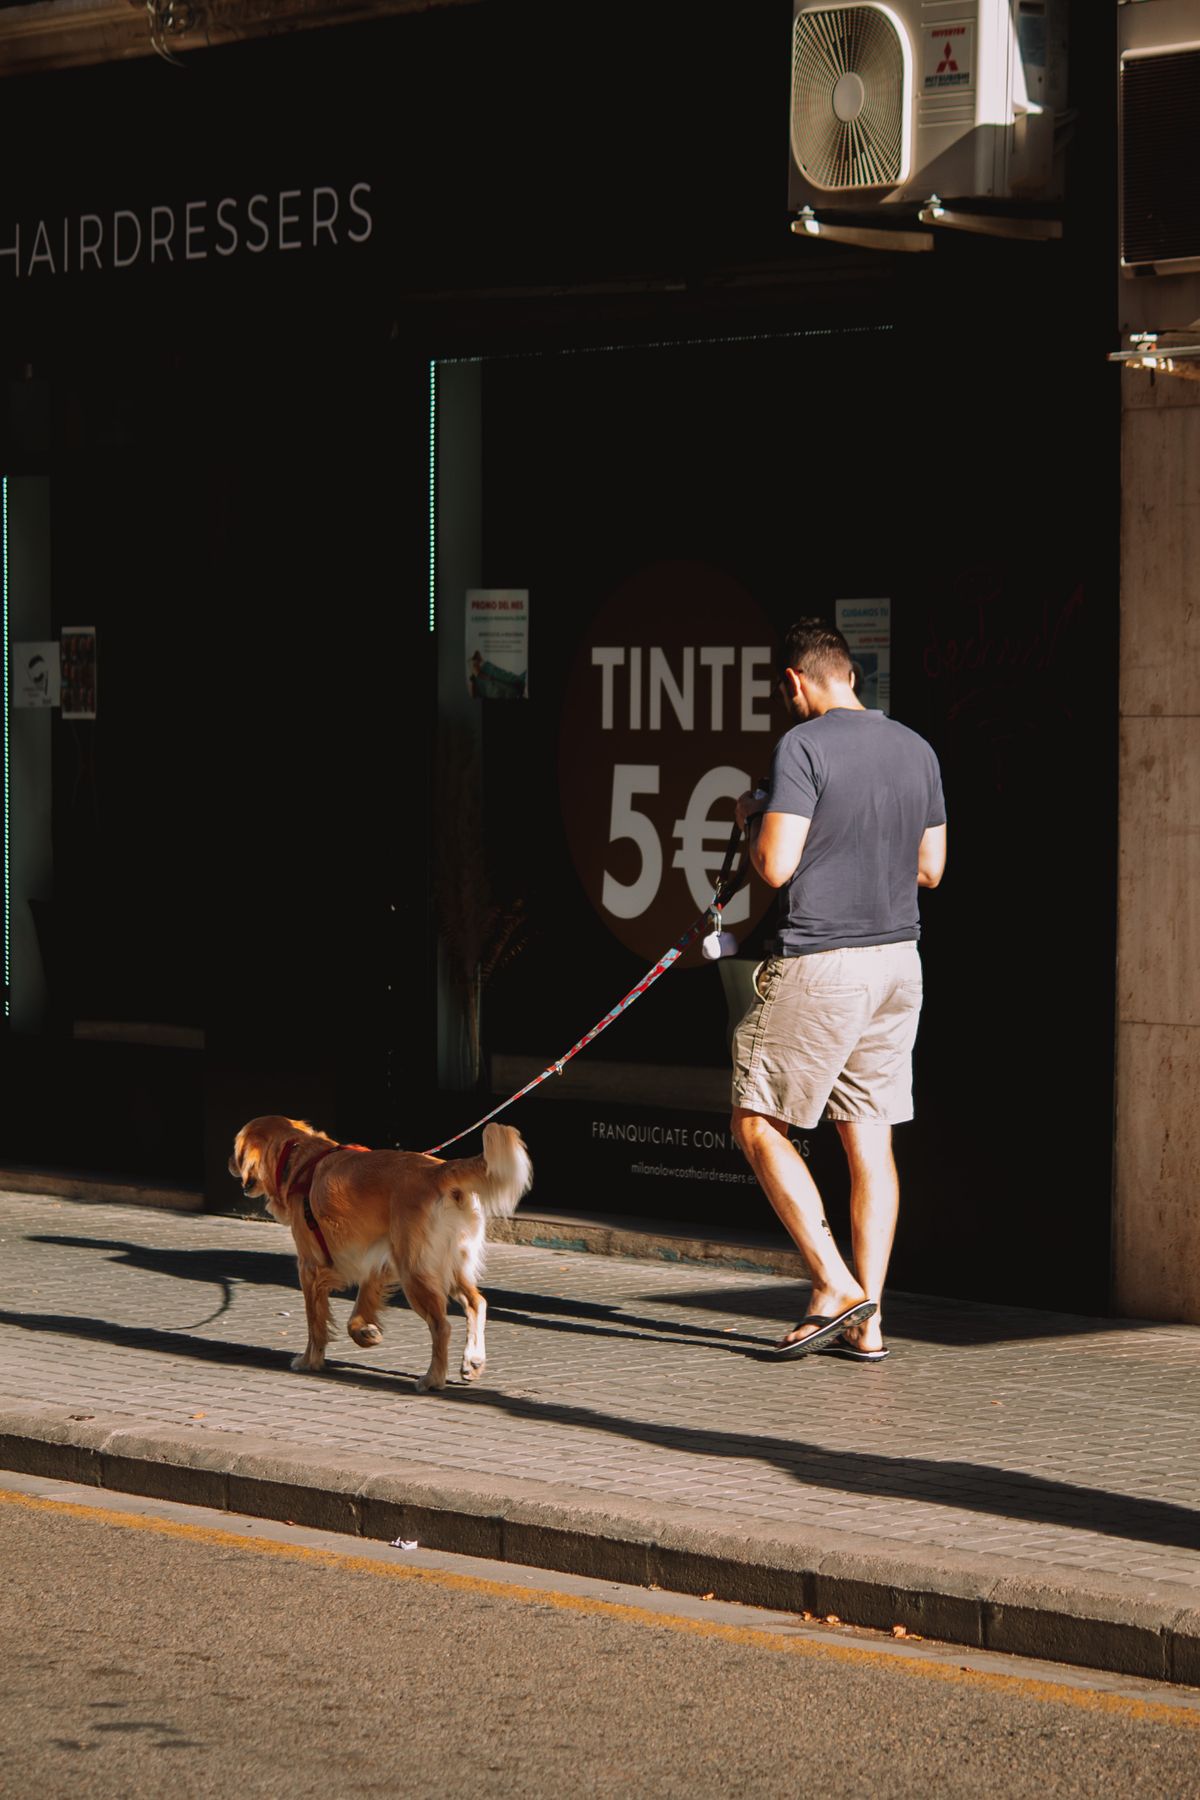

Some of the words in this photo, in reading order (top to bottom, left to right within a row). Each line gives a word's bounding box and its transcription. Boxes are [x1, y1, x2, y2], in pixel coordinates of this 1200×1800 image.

[0, 182, 373, 277] HAIRDRESSERS
[591, 646, 771, 732] TINTE
[601, 763, 752, 925] 5€
[591, 1121, 688, 1147] FRANQUICIATE
[693, 1130, 726, 1150] CON
